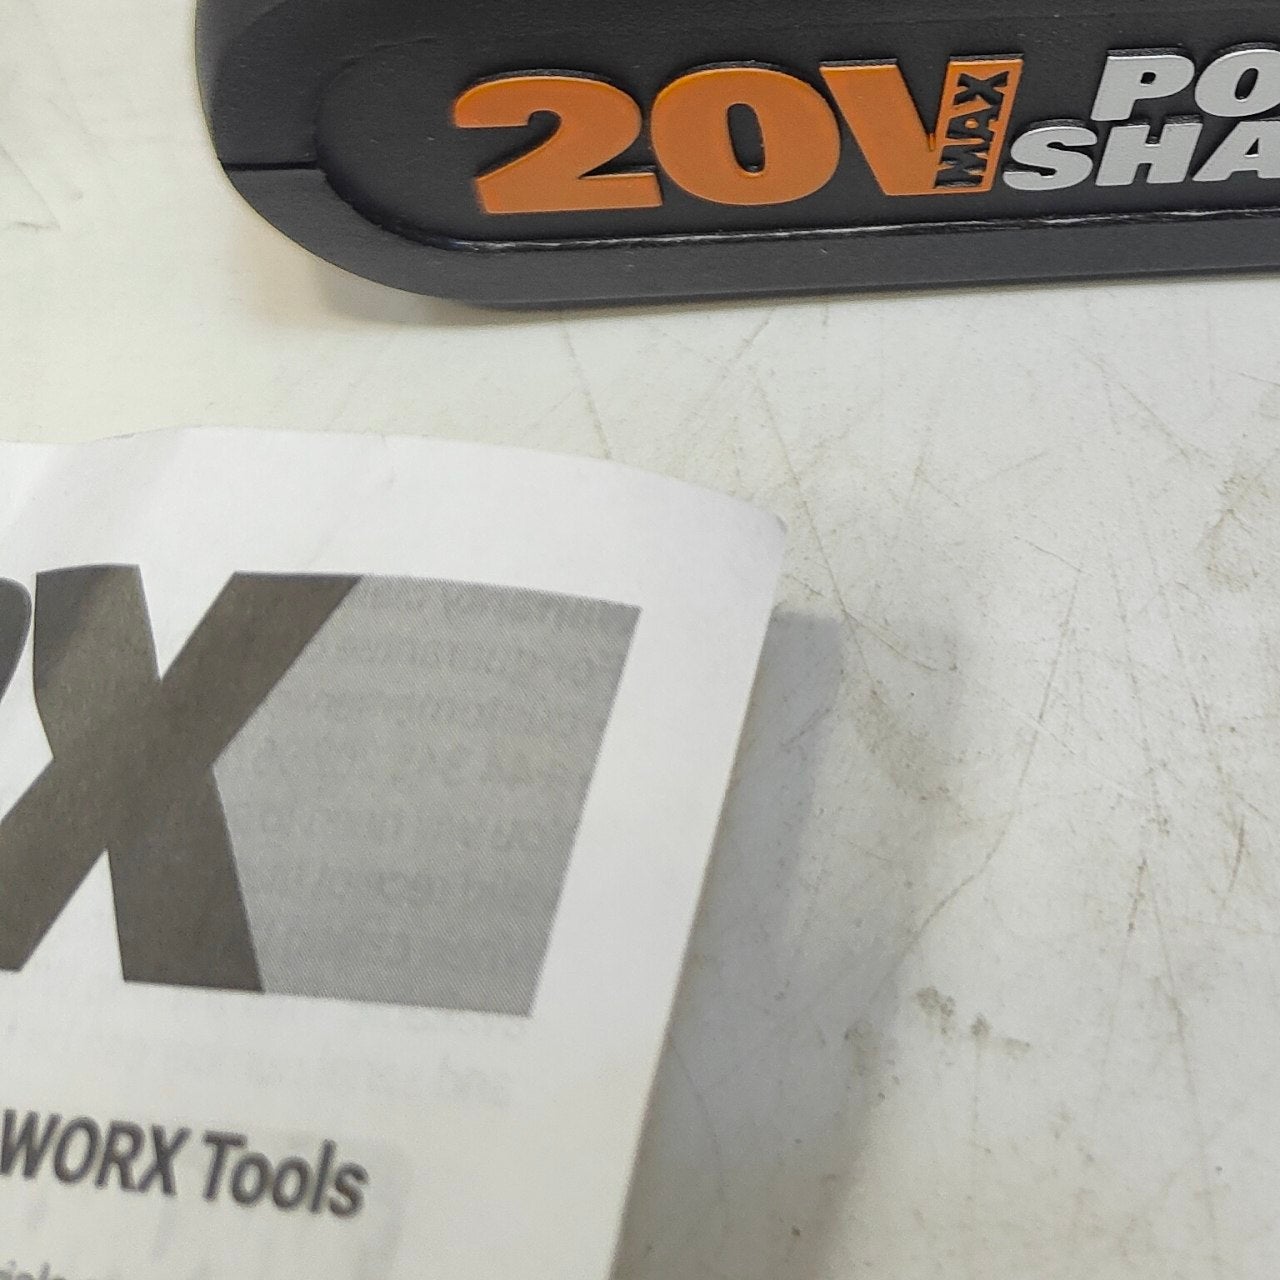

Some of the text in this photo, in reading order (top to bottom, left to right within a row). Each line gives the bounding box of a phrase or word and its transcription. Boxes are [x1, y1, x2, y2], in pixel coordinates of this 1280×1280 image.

[453, 57, 1023, 214] 20V
[934, 71, 1010, 190] MAX
[0, 1108, 370, 1220] WORX Tools
